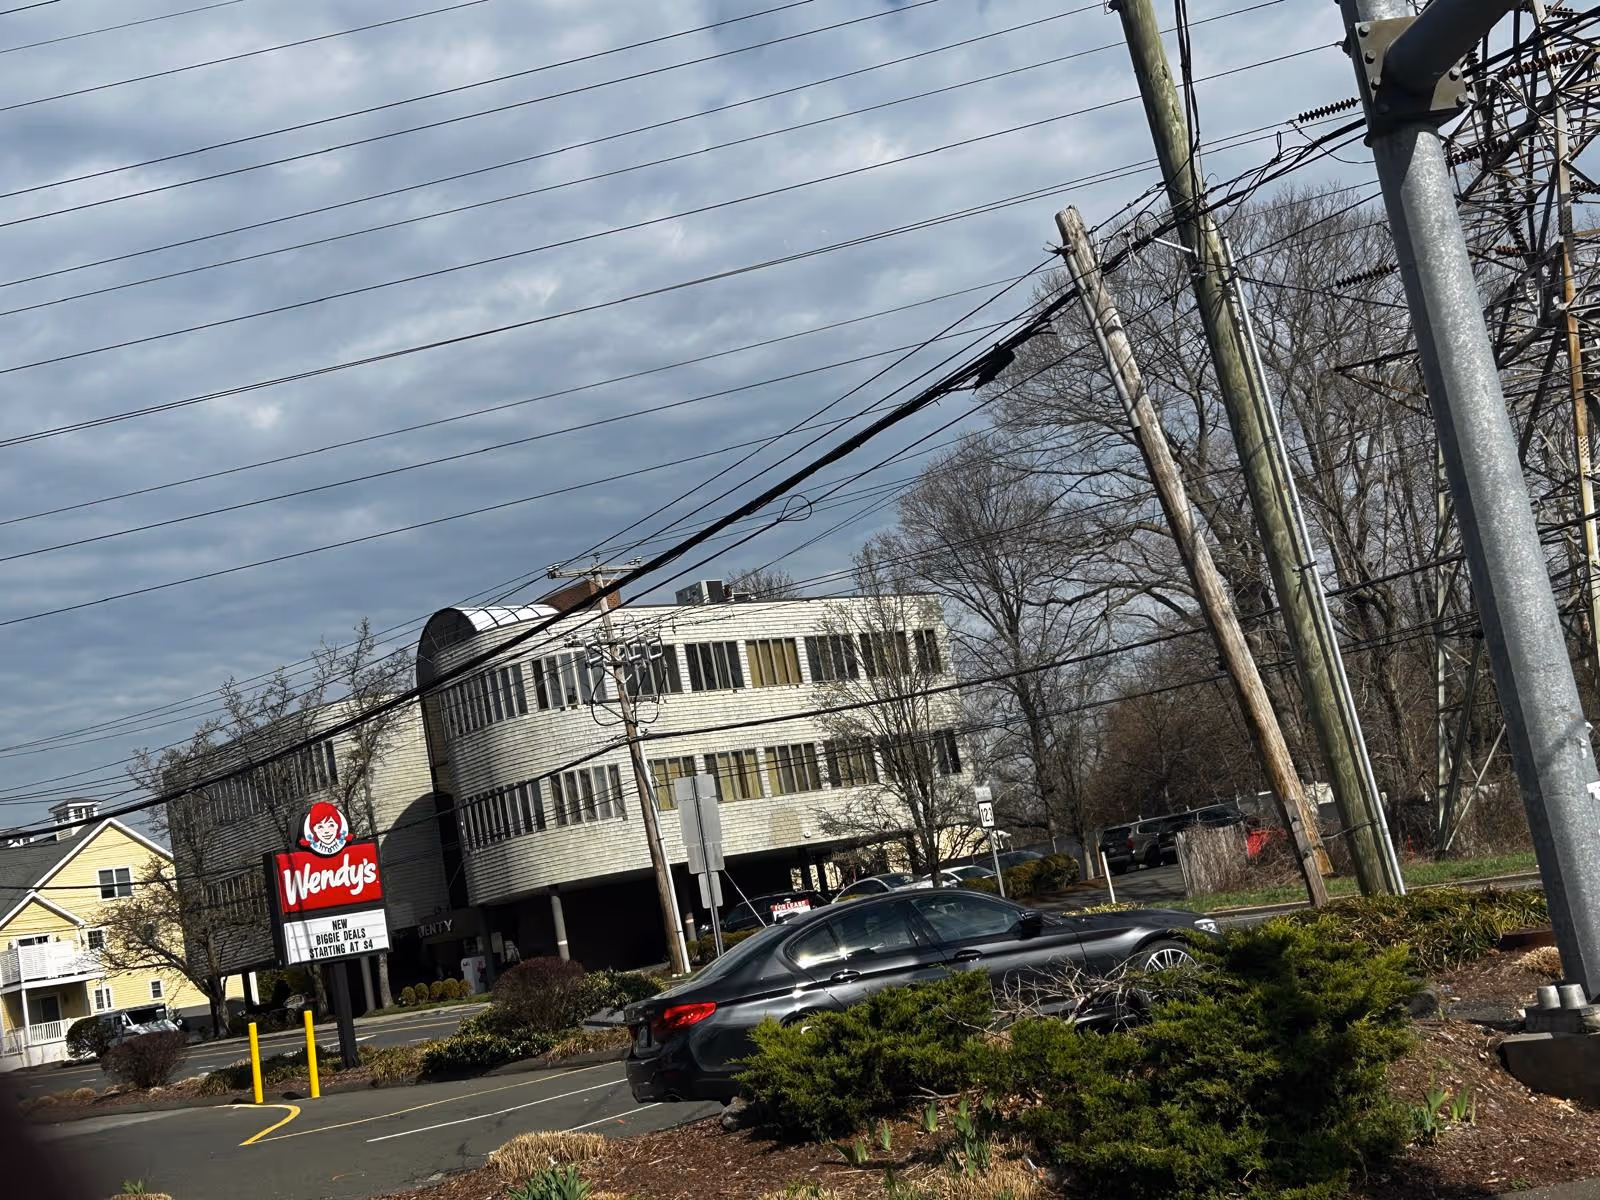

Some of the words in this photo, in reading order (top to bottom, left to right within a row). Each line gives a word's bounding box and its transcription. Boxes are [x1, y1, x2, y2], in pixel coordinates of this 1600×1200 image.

[981, 807, 992, 822] 123
[283, 853, 376, 906] Wendy's
[332, 918, 347, 931] NEW
[316, 933, 340, 945] BIGGIE
[343, 928, 366, 940] DEALS
[309, 943, 346, 959] STARTING
[350, 941, 359, 953] AT
